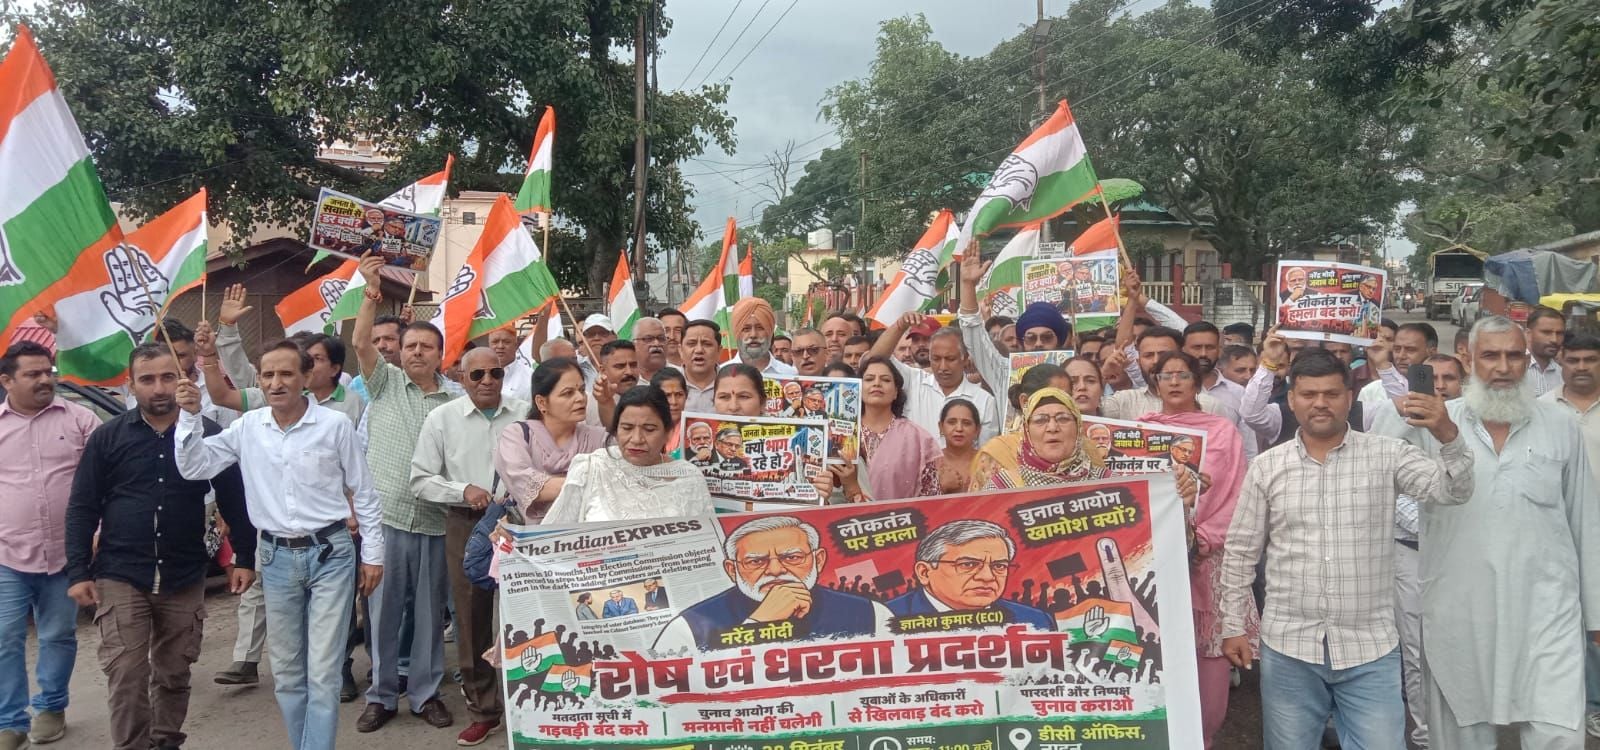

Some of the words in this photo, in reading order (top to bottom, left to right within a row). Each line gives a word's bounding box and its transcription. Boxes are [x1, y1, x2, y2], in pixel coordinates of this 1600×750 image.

[1298, 294, 1336, 308] लोकतंत्र
[1340, 296, 1352, 305] पर
[1289, 308, 1316, 320] हमला
[745, 439, 765, 454] क्यों
[766, 438, 789, 452] भाग
[752, 454, 768, 470] रहे
[1147, 460, 1161, 470] पर
[1017, 502, 1065, 526] चुनाव
[1069, 491, 1121, 512] आयोग
[837, 512, 912, 537] लोकतंत्र
[1025, 516, 1088, 540] खामोश
[1092, 504, 1136, 528] क्यों?
[516, 543, 550, 556] The
[554, 534, 614, 553] Indian
[614, 520, 702, 544] EXPRESS
[844, 536, 869, 550] पर
[872, 526, 918, 547] हमला
[503, 572, 512, 581] 14
[601, 560, 632, 571] Election
[634, 553, 683, 566] Commission
[685, 546, 716, 558] objected
[576, 573, 597, 582] taken
[682, 555, 711, 565] keeping
[624, 572, 646, 581] voters
[662, 565, 692, 574] deleting
[899, 615, 937, 630] ज्ञानेश
[940, 614, 973, 629] कुमार
[976, 610, 1004, 624] (ECI)
[720, 627, 755, 644] नरेंद्र
[759, 622, 794, 639] मोदी
[593, 650, 694, 700] रोष
[702, 649, 755, 689] एवं
[763, 640, 894, 682] धरना
[904, 625, 1069, 673] प्रदर्शन
[860, 693, 896, 708] युवाओं
[899, 692, 912, 704] के
[1020, 686, 1065, 698] पारदर्शी
[1068, 685, 1090, 696] और
[698, 708, 731, 720] चुनाव
[735, 704, 774, 717] आयोग
[776, 701, 794, 714] की
[848, 708, 862, 723] से
[866, 704, 926, 722] खिलवाड़
[930, 703, 951, 717] बंद
[954, 700, 984, 716] करो
[1031, 700, 1077, 716] चुनाव
[1080, 696, 1134, 712] कराओ
[552, 712, 592, 722] मतदाता
[596, 709, 618, 723] सूची
[622, 709, 632, 720] में
[682, 718, 744, 733] मनमानी
[747, 715, 776, 733] नहीं
[779, 712, 823, 730] चलेगी
[593, 721, 616, 736] बंद
[619, 720, 649, 736] करो
[1038, 724, 1076, 740] डीसी
[1081, 723, 1146, 740] ऑफिस,
[906, 735, 936, 746] समय:
